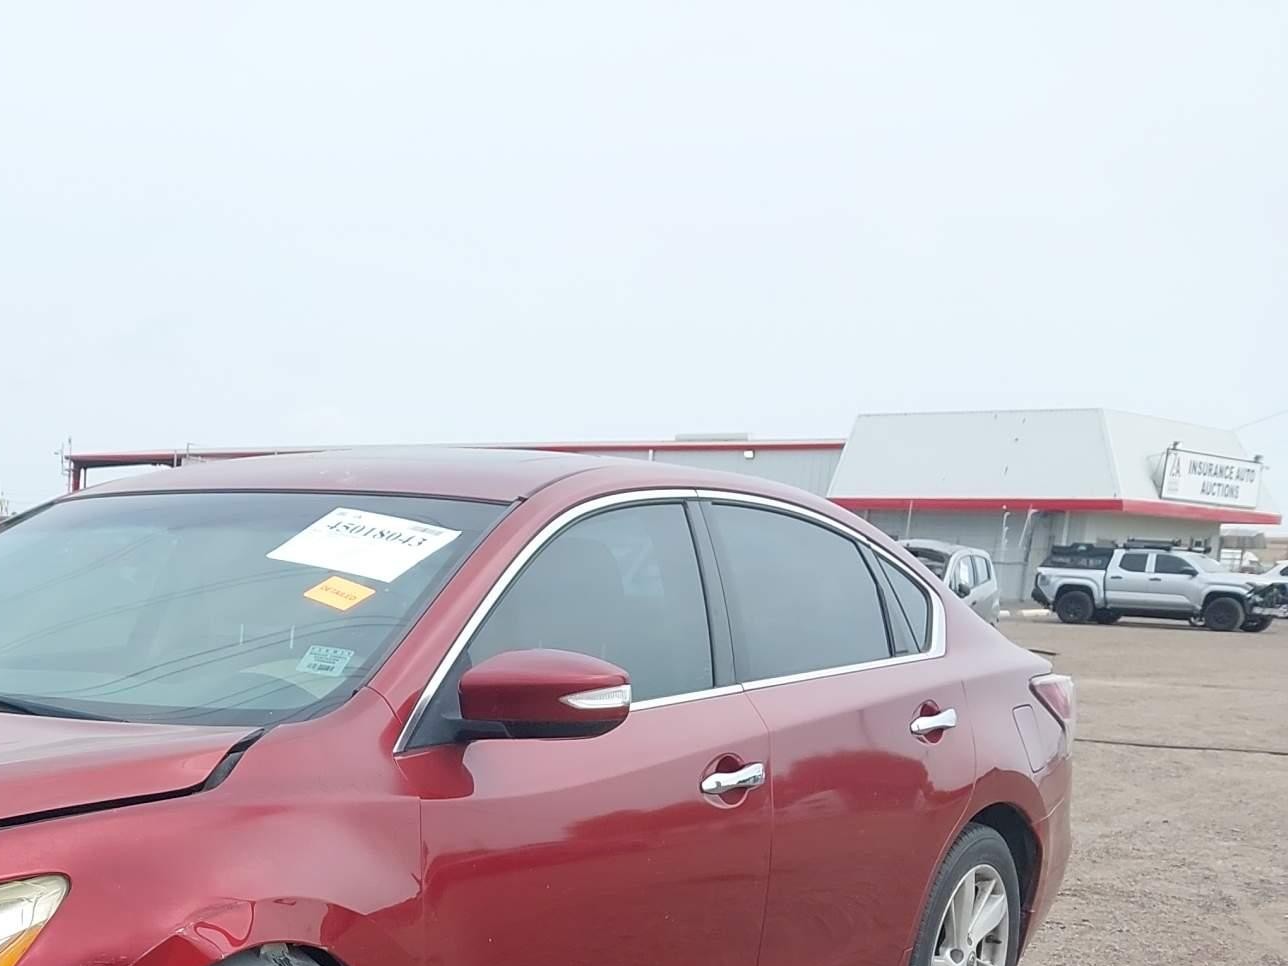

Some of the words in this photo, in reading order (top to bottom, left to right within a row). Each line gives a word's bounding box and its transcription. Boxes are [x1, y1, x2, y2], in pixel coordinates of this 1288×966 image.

[1188, 460, 1234, 480] INSURANCE
[1235, 467, 1256, 482] AUTO
[1200, 480, 1239, 499] AUCTIONS
[327, 520, 428, 548] 45018043
